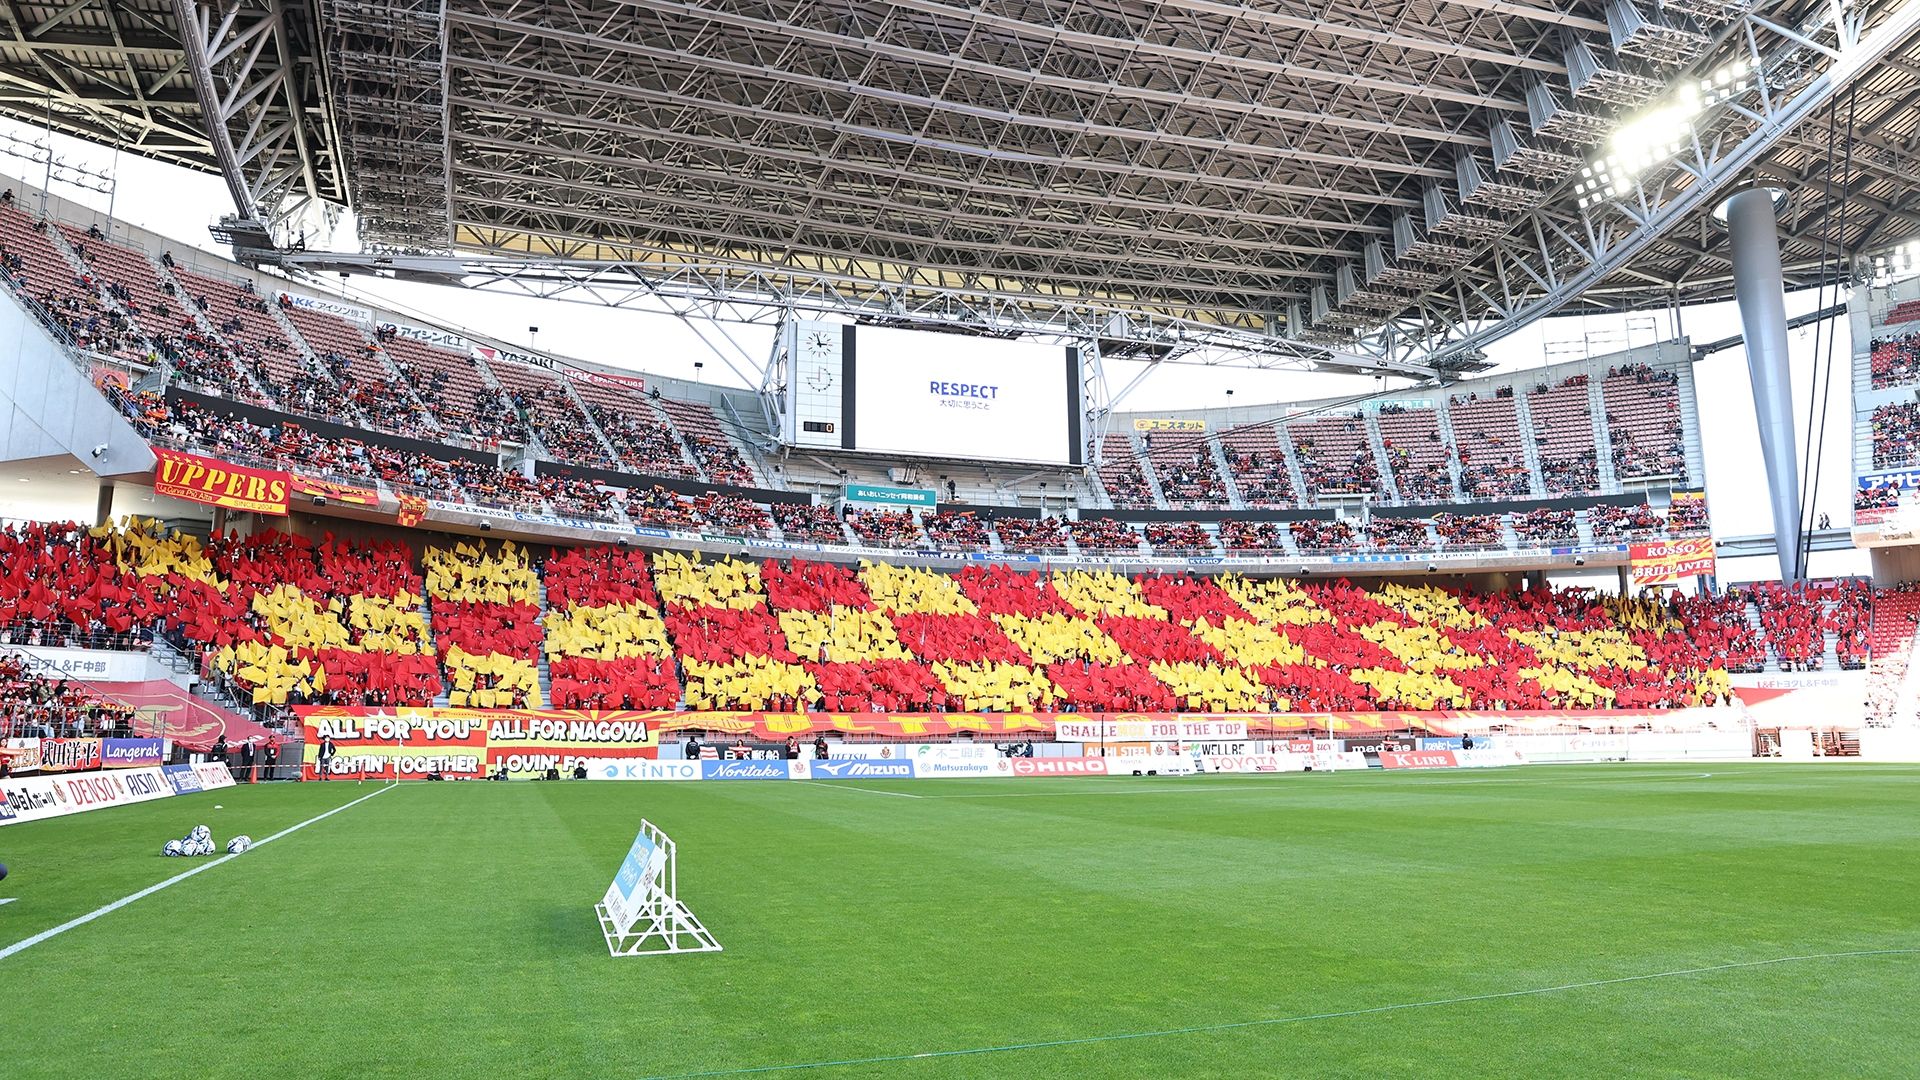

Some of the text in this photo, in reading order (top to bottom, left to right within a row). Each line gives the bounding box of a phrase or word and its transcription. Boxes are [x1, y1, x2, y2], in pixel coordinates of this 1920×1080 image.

[401, 326, 464, 347] アイシン化工
[499, 351, 555, 368] YAZAKI
[564, 369, 592, 383] NGK
[619, 378, 644, 387] PLUGS
[930, 381, 998, 399] RESPECT
[940, 399, 990, 411] 大切に思うこと
[1151, 421, 1203, 430] ユースネット
[161, 459, 286, 502] UPPERS
[233, 500, 256, 509] SINCE
[705, 536, 742, 545] MARUTAKA
[751, 540, 784, 549] TOYO
[984, 554, 1028, 562] HOMEX
[1647, 544, 1695, 557] ROSSO
[1634, 559, 1712, 578] BRILLANTE
[317, 718, 482, 741] ALL FOR "YOU"
[489, 719, 649, 742] ALL FOR NAGOYA
[1061, 724, 1146, 737] CHALLENGE
[1152, 724, 1178, 736] FOR
[1183, 723, 1211, 735] THE
[1216, 722, 1242, 734] TOP
[41, 740, 98, 767] 武田洋平
[106, 743, 160, 762] Langerak
[1202, 743, 1245, 756] WELLBE
[1352, 743, 1411, 752] madas
[391, 755, 478, 775] TOGETHER
[496, 754, 560, 772] LOVIN'
[934, 763, 988, 774] Matsuzakaya
[1036, 761, 1105, 773] HINO
[1412, 756, 1448, 765] LINE
[200, 767, 228, 785] TOYOTA
[707, 762, 784, 777] Noritake
[66, 776, 116, 806] DENSO
[125, 772, 161, 797] AISIN
[6, 787, 57, 811] 中日スポーツ
